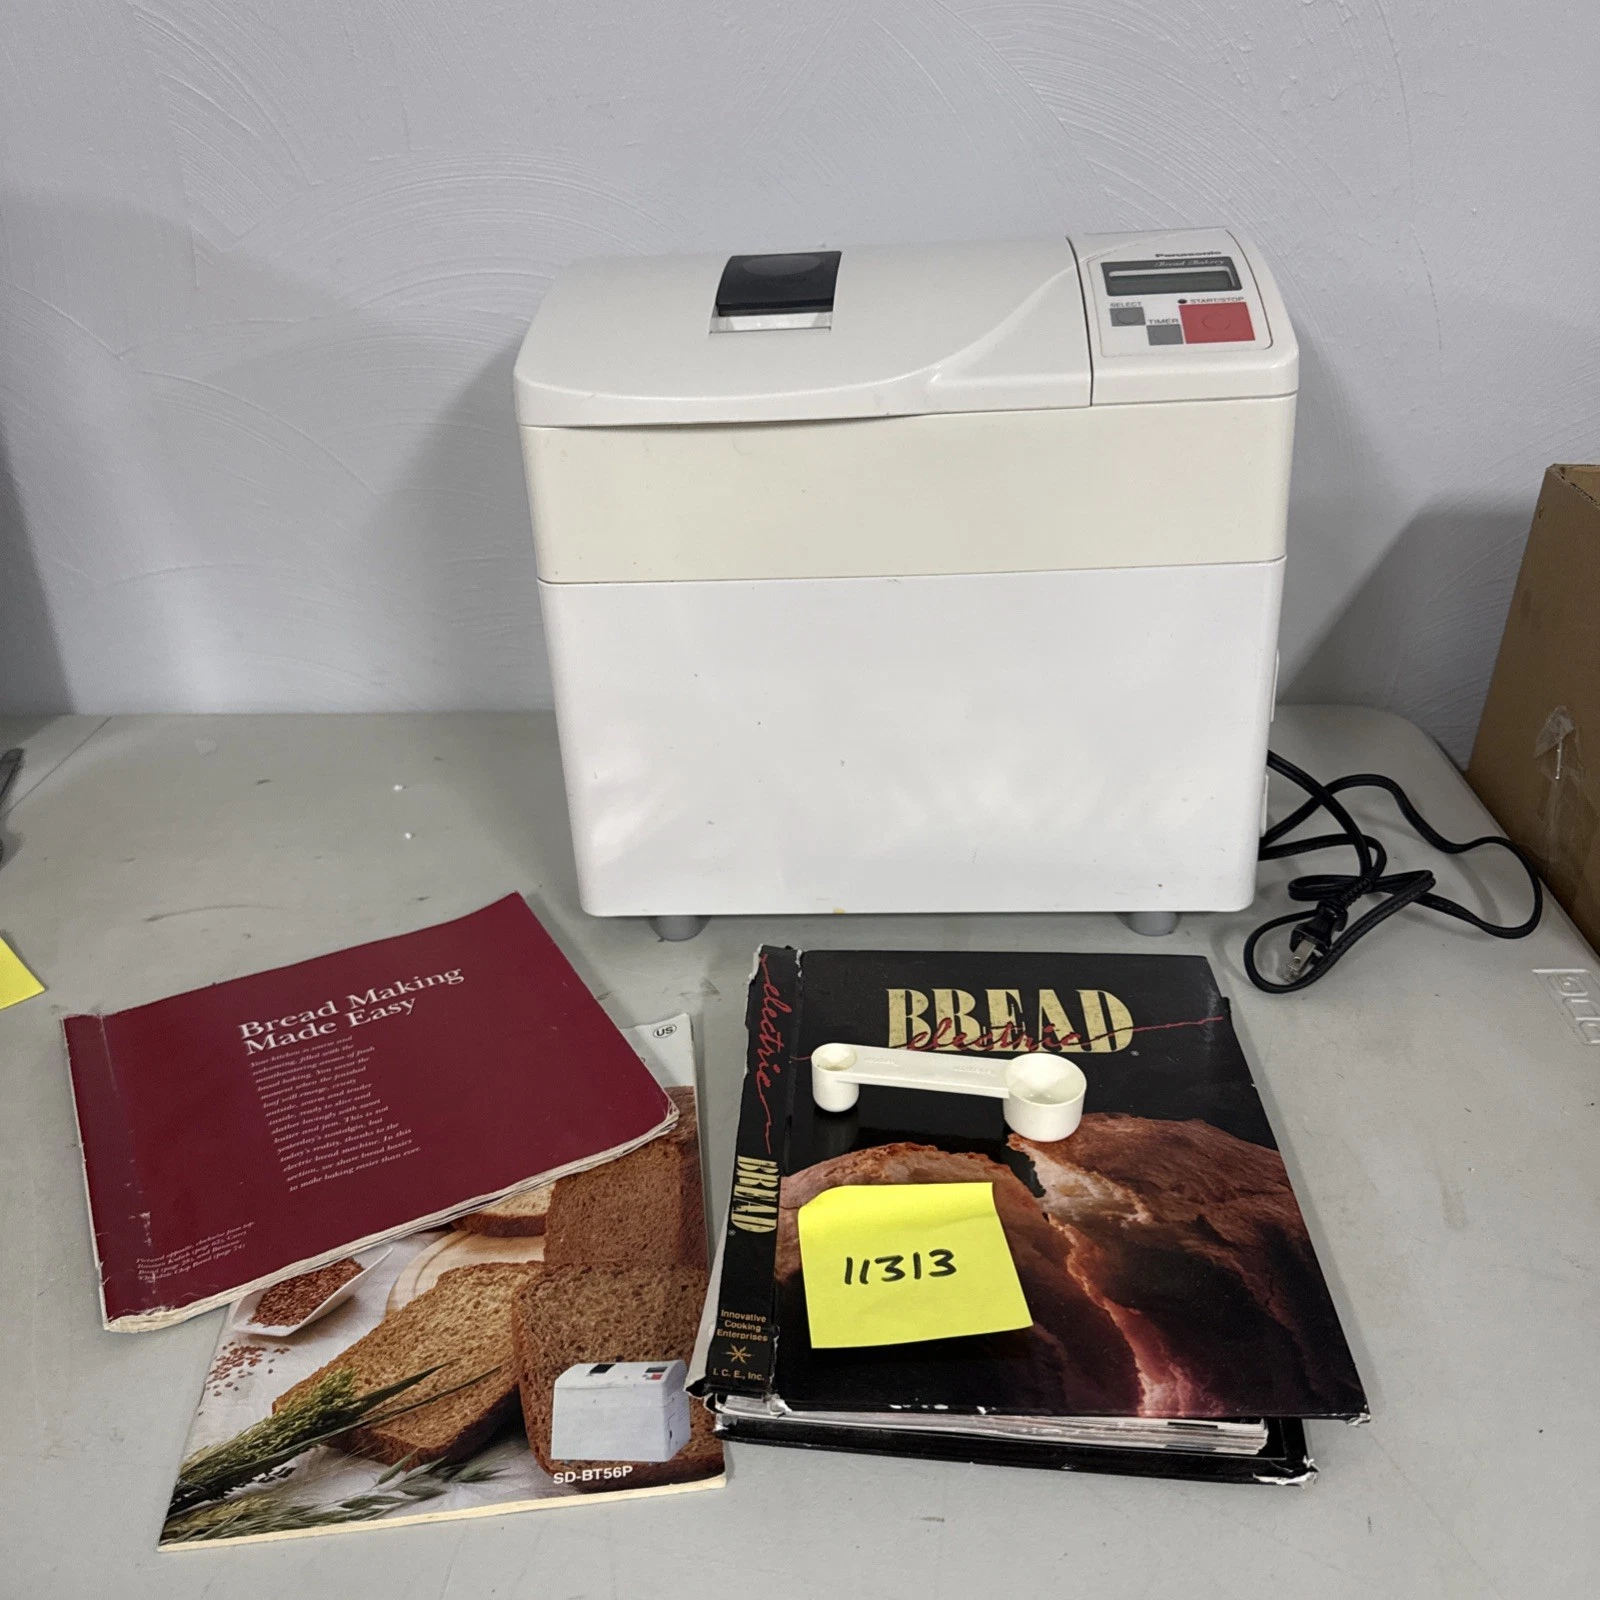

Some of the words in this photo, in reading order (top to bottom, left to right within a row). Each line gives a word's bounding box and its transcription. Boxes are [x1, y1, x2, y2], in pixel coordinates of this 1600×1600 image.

[1187, 259, 1225, 267] Bakery
[238, 1001, 339, 1039] Bread
[346, 968, 465, 1009] Making
[244, 1023, 337, 1056] Made
[344, 998, 416, 1028] Easy
[885, 988, 1135, 1054] BREAD
[656, 1026, 673, 1036] US
[728, 1155, 778, 1233] BREAD
[843, 1248, 958, 1286] 11313
[720, 1310, 767, 1322] Innovative
[724, 1320, 762, 1333] Cooking
[716, 1329, 768, 1342] Enterprises
[721, 1369, 730, 1377] C.
[734, 1370, 746, 1379] E.,
[748, 1372, 764, 1380] Inc.
[553, 1466, 634, 1484] SD-BT56P
